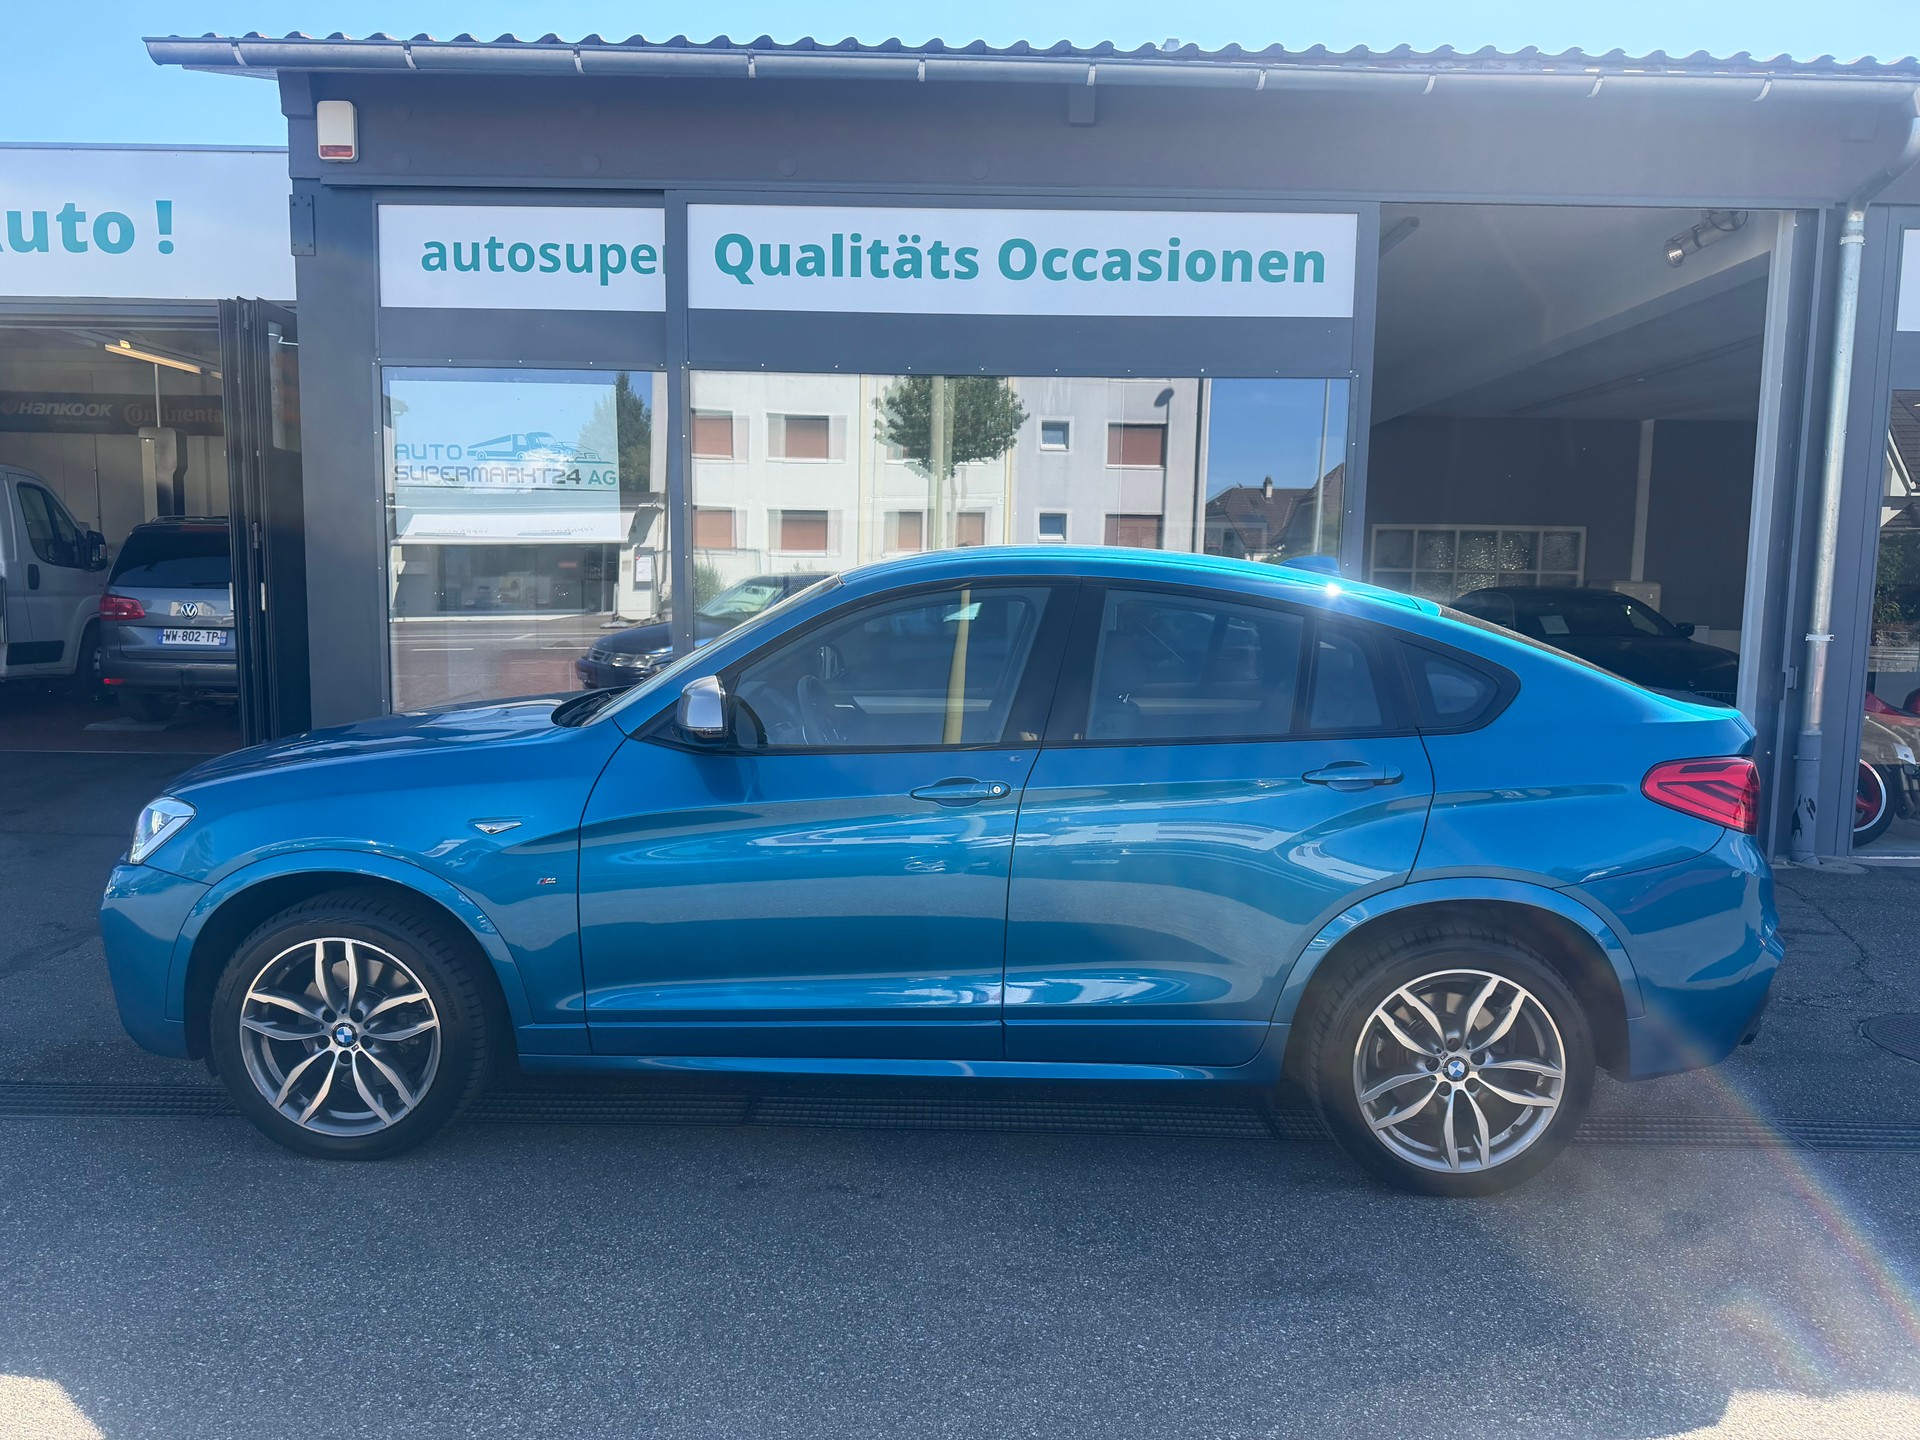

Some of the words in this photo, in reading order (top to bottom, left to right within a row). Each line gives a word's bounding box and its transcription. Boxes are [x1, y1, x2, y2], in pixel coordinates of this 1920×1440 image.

[0, 202, 136, 255] uto
[713, 232, 980, 285] Qualitäts
[997, 236, 1325, 284] Occasionen
[394, 443, 462, 461] AUTO
[394, 465, 582, 485] SUPERMARKT24
[587, 469, 617, 486] AG
